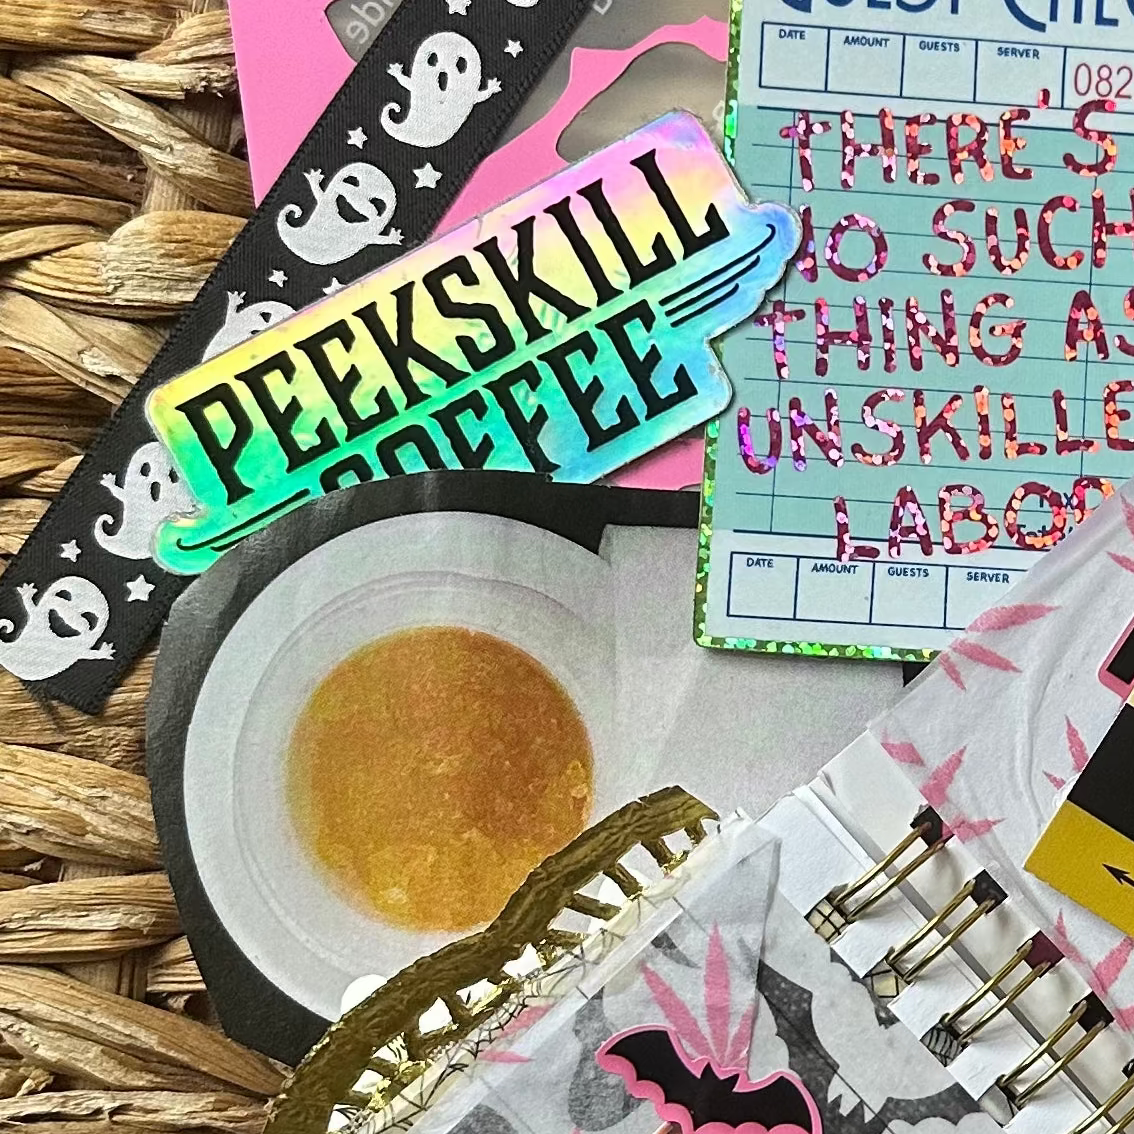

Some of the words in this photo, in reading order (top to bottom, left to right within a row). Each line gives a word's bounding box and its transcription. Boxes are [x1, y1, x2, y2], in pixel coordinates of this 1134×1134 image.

[778, 28, 806, 41] DATE
[842, 35, 890, 49] AMOUNT
[918, 40, 961, 53] GUESTS
[996, 46, 1040, 60] SERVER
[780, 88, 1119, 192] THERE'S
[175, 148, 730, 505] PEEKSKILL
[753, 289, 1027, 380] THING
[320, 298, 699, 494] FFEE
[746, 558, 774, 569] DATE
[811, 563, 859, 575] AMOUNT
[887, 566, 930, 578] GUESTS
[966, 571, 1010, 584] SERVER
